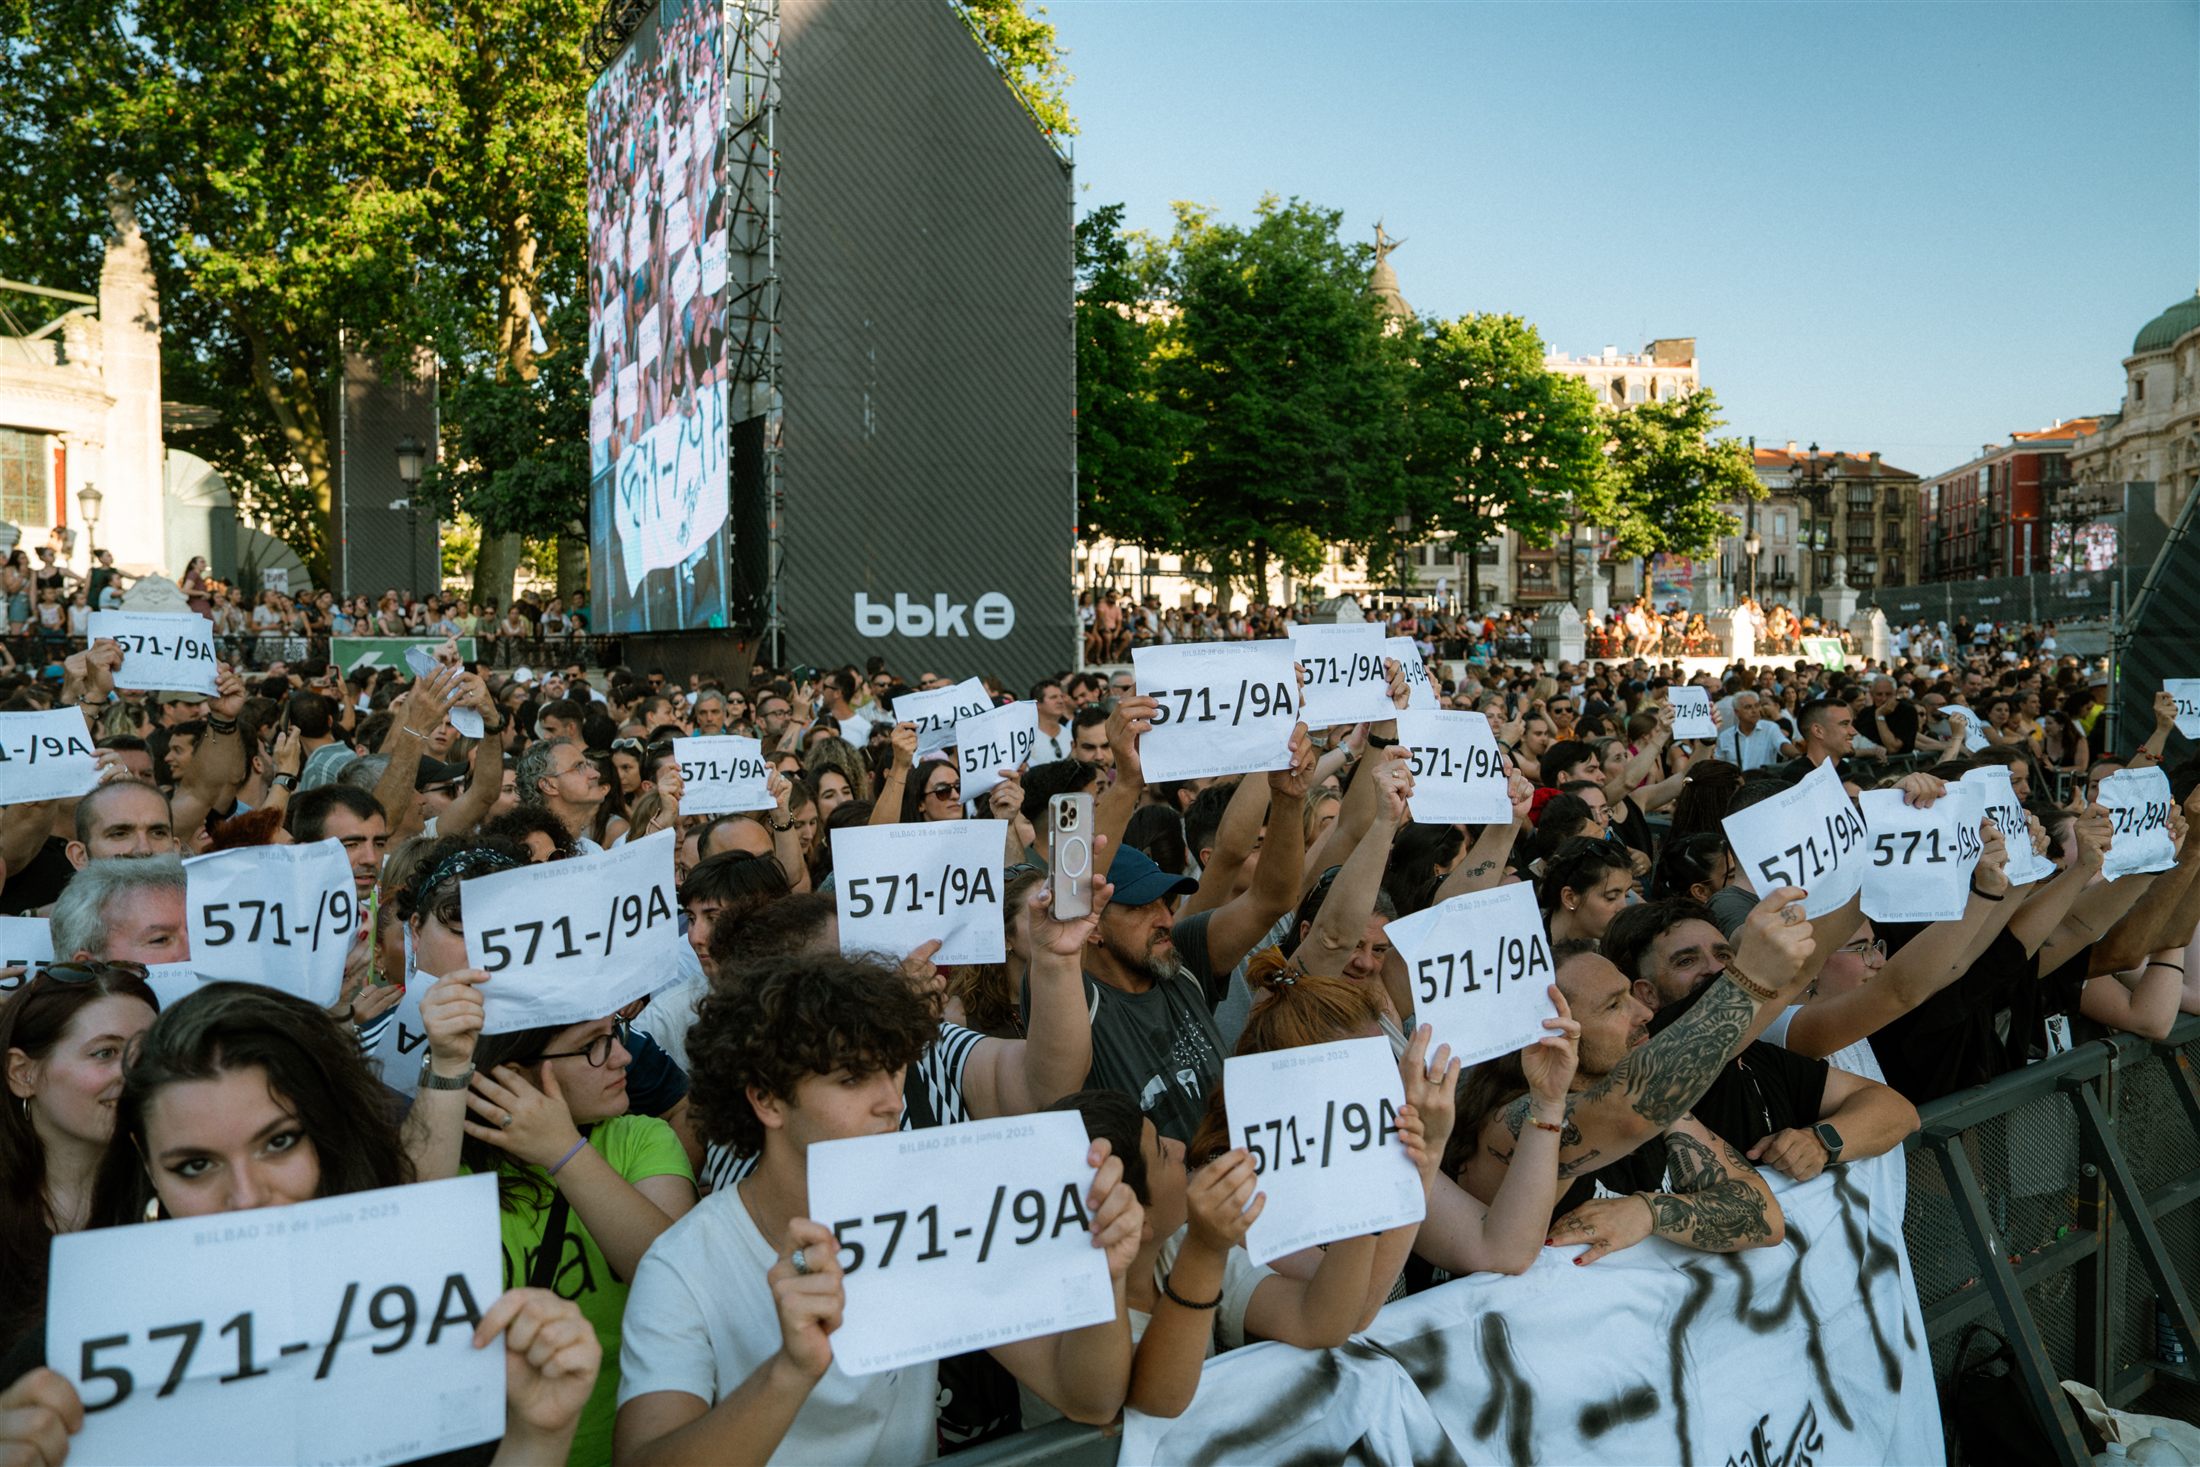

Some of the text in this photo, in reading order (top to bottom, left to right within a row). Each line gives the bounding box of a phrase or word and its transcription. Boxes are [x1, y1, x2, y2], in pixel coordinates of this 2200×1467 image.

[854, 592, 970, 637] bbk
[1301, 653, 1385, 687] 571-/9A
[908, 702, 987, 734] 71-/9A
[1148, 680, 1293, 726] 571-/9A
[1673, 702, 1709, 719] 71-/9A
[681, 758, 766, 783] 571-/9A
[1410, 745, 1508, 783] 571-/9A
[2109, 801, 2169, 837] 71-/9A
[1873, 822, 1981, 867] 571-/9A
[533, 867, 569, 881] BILBAO
[849, 864, 996, 918] 571-/9A
[203, 890, 361, 951] 571-/9
[481, 884, 672, 972] 571-/9A
[1418, 934, 1549, 1003] 571-/9A
[1326, 1050, 1350, 1061] 2025
[899, 1139, 940, 1154] BILBAO
[943, 1135, 957, 1148] 28
[960, 1133, 973, 1145] de
[1006, 1125, 1035, 1139] 2025
[1244, 1098, 1399, 1176] 571-/9A
[194, 1203, 400, 1246] BILBAO 28 de junio 2025
[833, 1183, 1090, 1275] 571-/9A
[80, 1272, 484, 1413] 571-/9A
[376, 1440, 422, 1462] quitar
